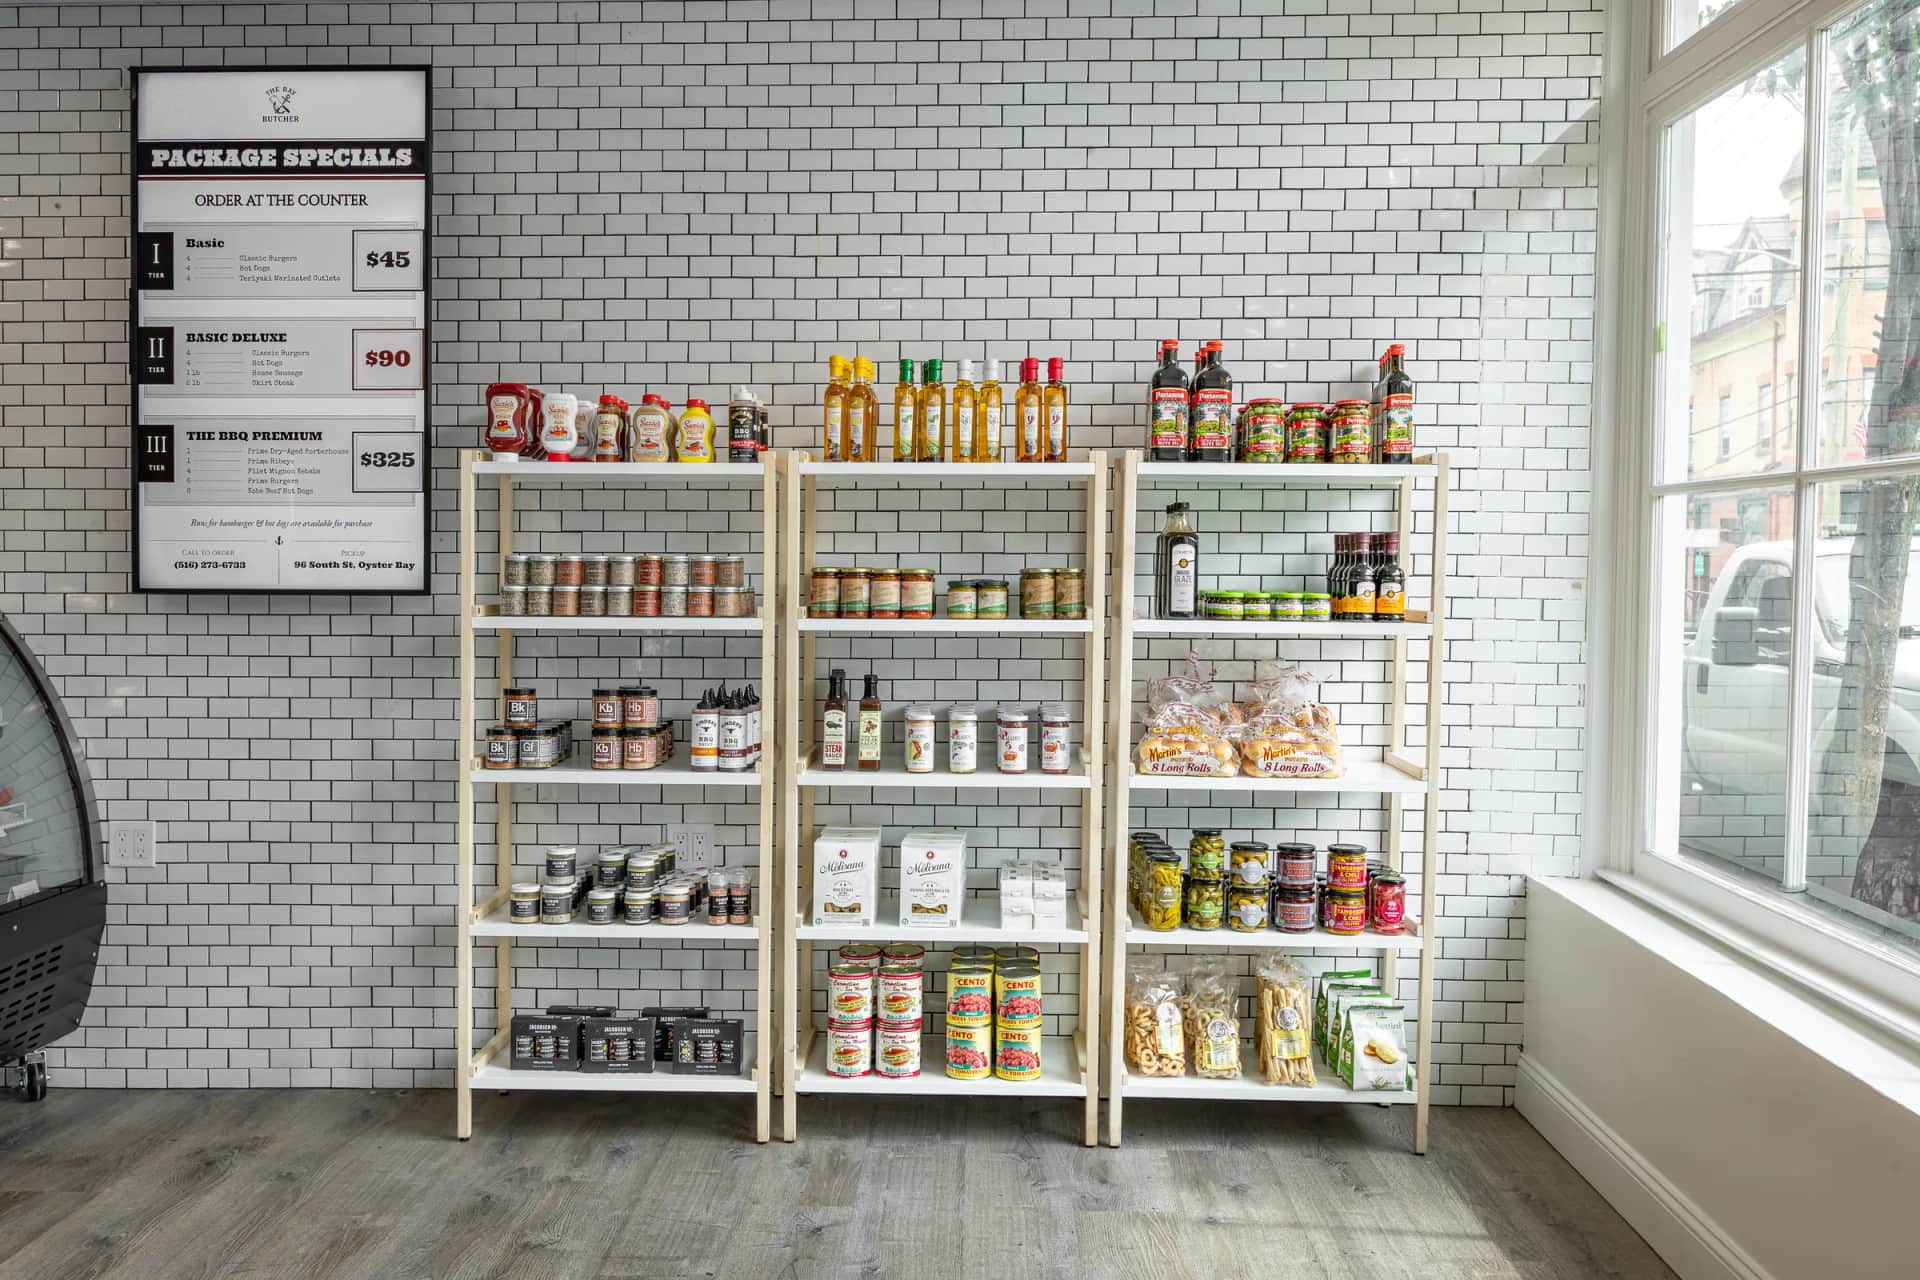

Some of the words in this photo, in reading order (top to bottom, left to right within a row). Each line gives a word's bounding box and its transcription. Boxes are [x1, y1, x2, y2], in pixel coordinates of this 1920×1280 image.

[265, 86, 281, 96] THE
[262, 115, 299, 123] BUTCHER
[151, 148, 277, 167] PACKAGE
[283, 148, 412, 167] SPECIALS
[194, 194, 245, 207] ORDER
[246, 194, 265, 207] AT
[266, 194, 295, 206] THE
[297, 194, 369, 207] COUNTER
[185, 238, 225, 249] Basic
[269, 255, 298, 263] Burgers
[366, 250, 411, 269] $45
[253, 265, 271, 273] Dogs
[239, 275, 273, 283] Teriyaki
[185, 333, 229, 343] BASIC
[231, 333, 288, 343] DELUXE
[149, 338, 165, 358] II
[281, 350, 310, 358] Burgers
[365, 350, 411, 367] $90
[266, 360, 283, 368] Dogs
[274, 370, 303, 378] Sausage
[186, 431, 216, 441] THE
[218, 431, 249, 442] BBQ
[251, 431, 322, 441] PREMIUM
[147, 436, 167, 453] III
[270, 448, 303, 456] Dry-Aged
[270, 458, 295, 466] Ribeye
[360, 451, 415, 468] $325
[269, 468, 296, 476] Mignon
[270, 478, 299, 486] Burgers
[297, 488, 314, 496] Dogs
[206, 519, 218, 529] for
[219, 519, 254, 529] hamburger
[256, 519, 264, 528] &
[265, 519, 274, 527] hot
[275, 519, 289, 529] dogs
[302, 519, 332, 527] available
[332, 519, 344, 529] for
[344, 519, 373, 529] purchase
[174, 561, 199, 570] (516)
[294, 561, 307, 569] 96
[309, 561, 340, 569] South
[342, 561, 356, 570] St.
[359, 561, 394, 571] Oyster
[396, 561, 415, 571] Bay
[511, 703, 525, 713] Bk
[599, 703, 613, 713] Kb
[628, 702, 641, 712] Hb
[490, 743, 504, 753] Bk
[523, 742, 535, 752] Gf
[595, 743, 608, 753] Kb
[628, 742, 641, 752] Hb
[825, 744, 843, 752] STEAK
[1149, 746, 1182, 763] Martin's
[1263, 746, 1296, 761] Martin's
[1151, 763, 1159, 772] 8
[1161, 763, 1185, 773] Long
[1187, 763, 1211, 772] Rolls
[1264, 762, 1272, 772] 8
[1273, 762, 1298, 773] Long
[1300, 763, 1325, 772] Rolls
[957, 978, 986, 986] CENTO
[1005, 981, 1034, 989] CENTO
[948, 1031, 973, 1039] CENTO
[1001, 1032, 1028, 1041] CENTO
